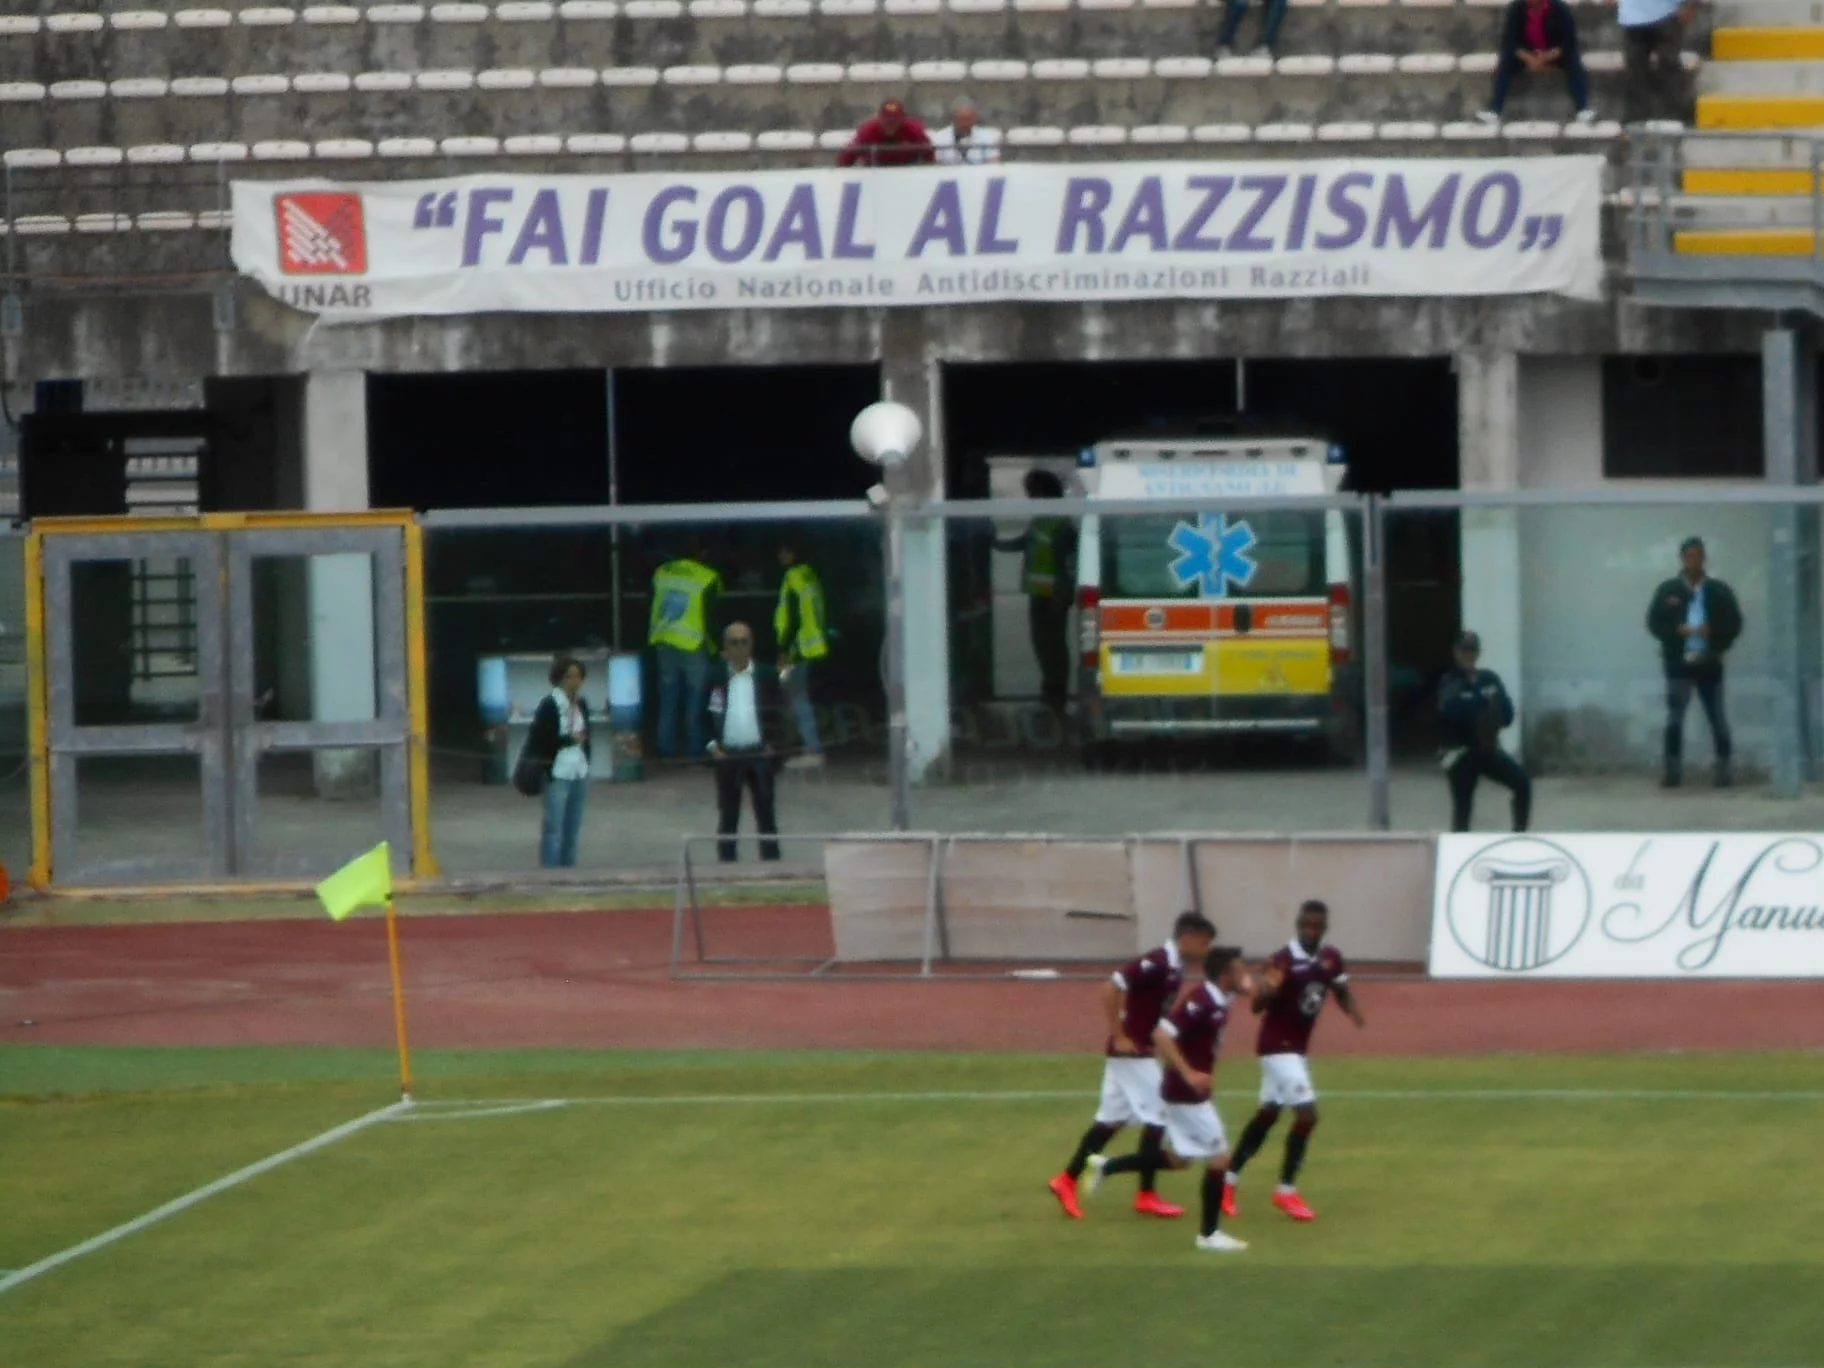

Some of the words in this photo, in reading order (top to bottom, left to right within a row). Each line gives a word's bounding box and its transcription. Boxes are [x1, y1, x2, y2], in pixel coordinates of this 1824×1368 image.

[641, 181, 876, 264] GOAL
[905, 177, 1020, 259] AL
[613, 277, 718, 303] Ufficio
[736, 271, 895, 299] Nazionale
[916, 265, 1230, 295] Antidiscriminazioni
[1249, 262, 1370, 289] Razziali
